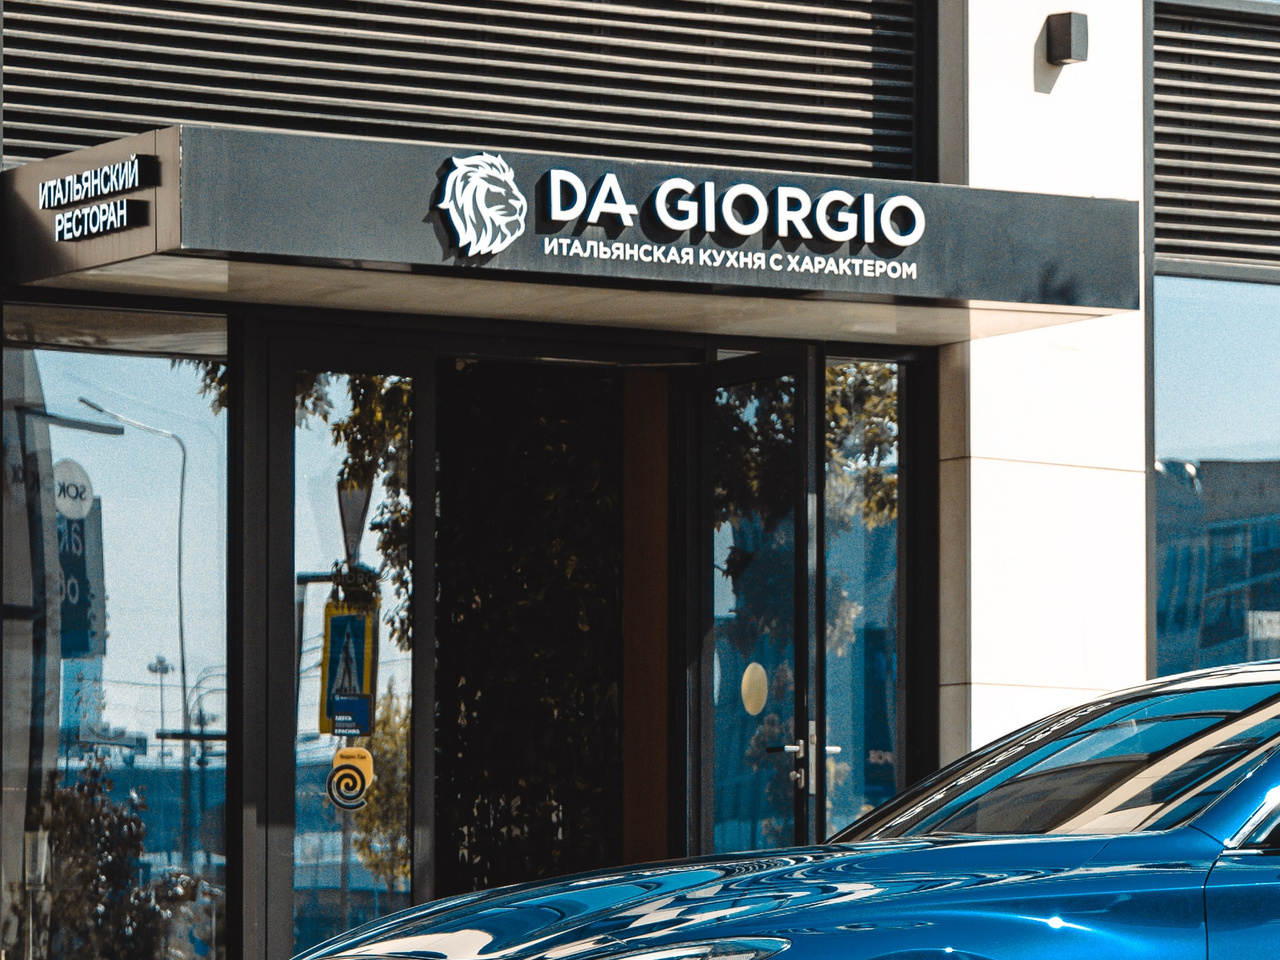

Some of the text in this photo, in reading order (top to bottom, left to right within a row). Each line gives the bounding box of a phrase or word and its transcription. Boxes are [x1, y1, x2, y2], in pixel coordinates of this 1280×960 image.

[38, 153, 140, 211] ИТАЛЬЯНСКИЙ
[54, 197, 128, 242] РЕСТОРАН
[549, 168, 927, 248] DA GIORGIO
[543, 236, 918, 281] ИТАЛЬЯНСКАЯ КУХНЯ С ХАРАКТЕРОМ
